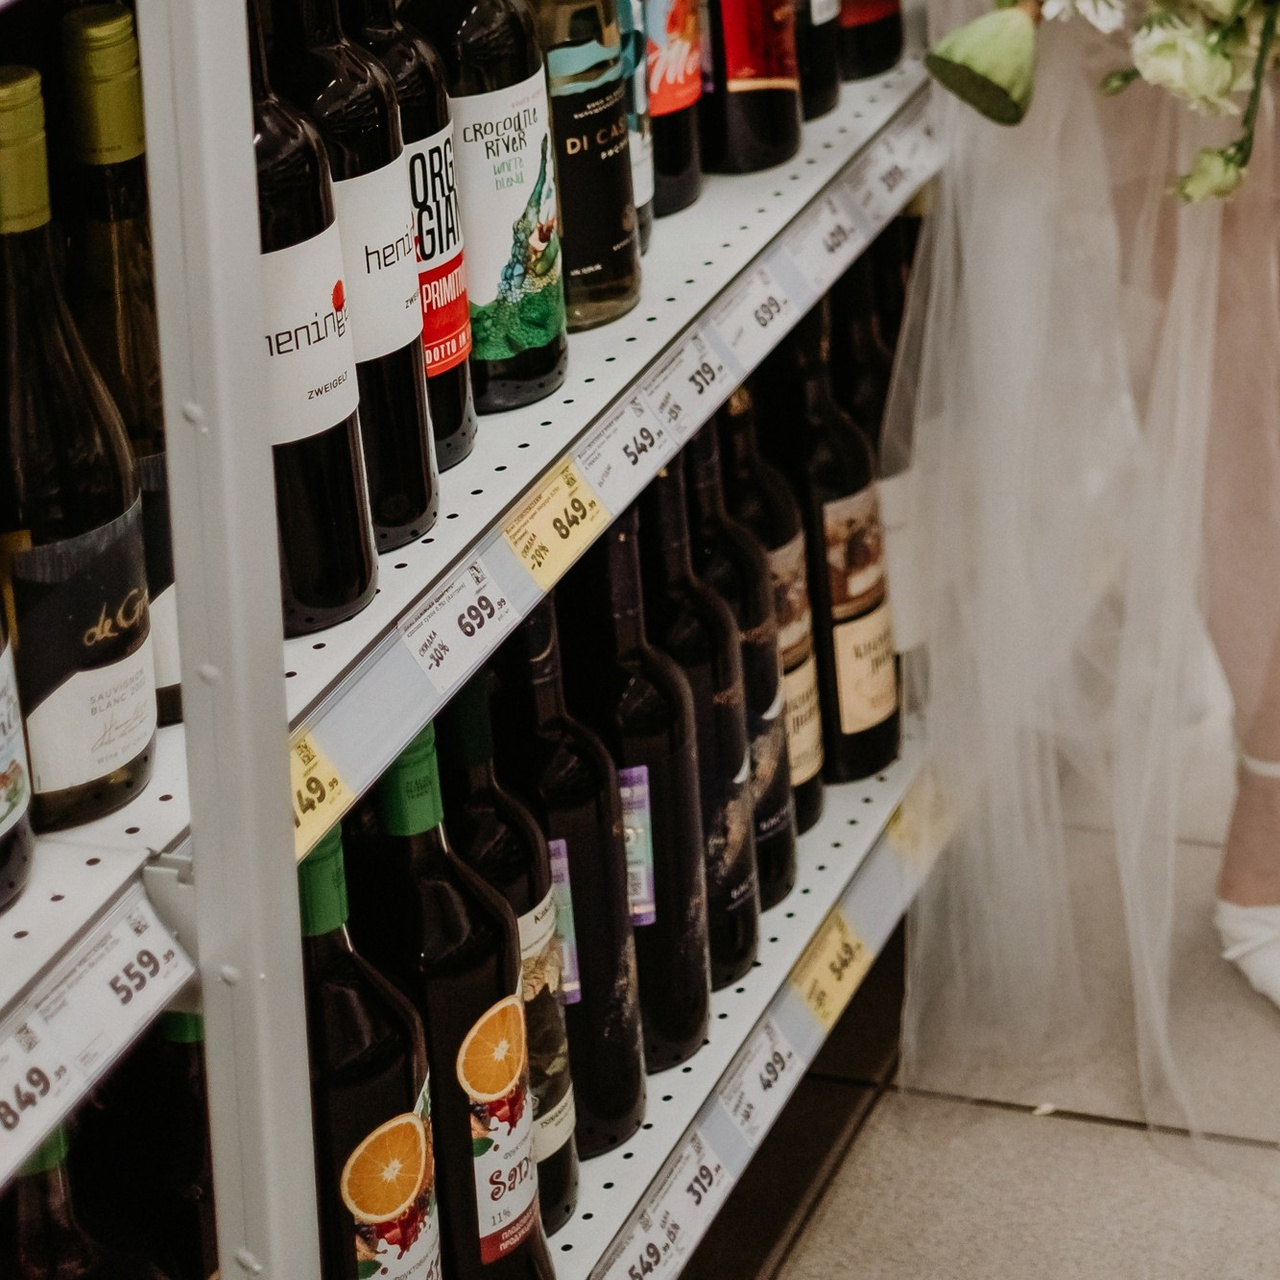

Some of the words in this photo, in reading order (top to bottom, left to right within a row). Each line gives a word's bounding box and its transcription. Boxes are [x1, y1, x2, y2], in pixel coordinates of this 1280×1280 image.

[566, 136, 589, 156] DI
[265, 301, 350, 358] ening
[425, 341, 457, 365] DOTTO
[307, 371, 348, 400] ZWEIGELT
[521, 533, 537, 558] СКИДКА
[419, 630, 437, 657] СКИДКА
[428, 640, 450, 670] -30%
